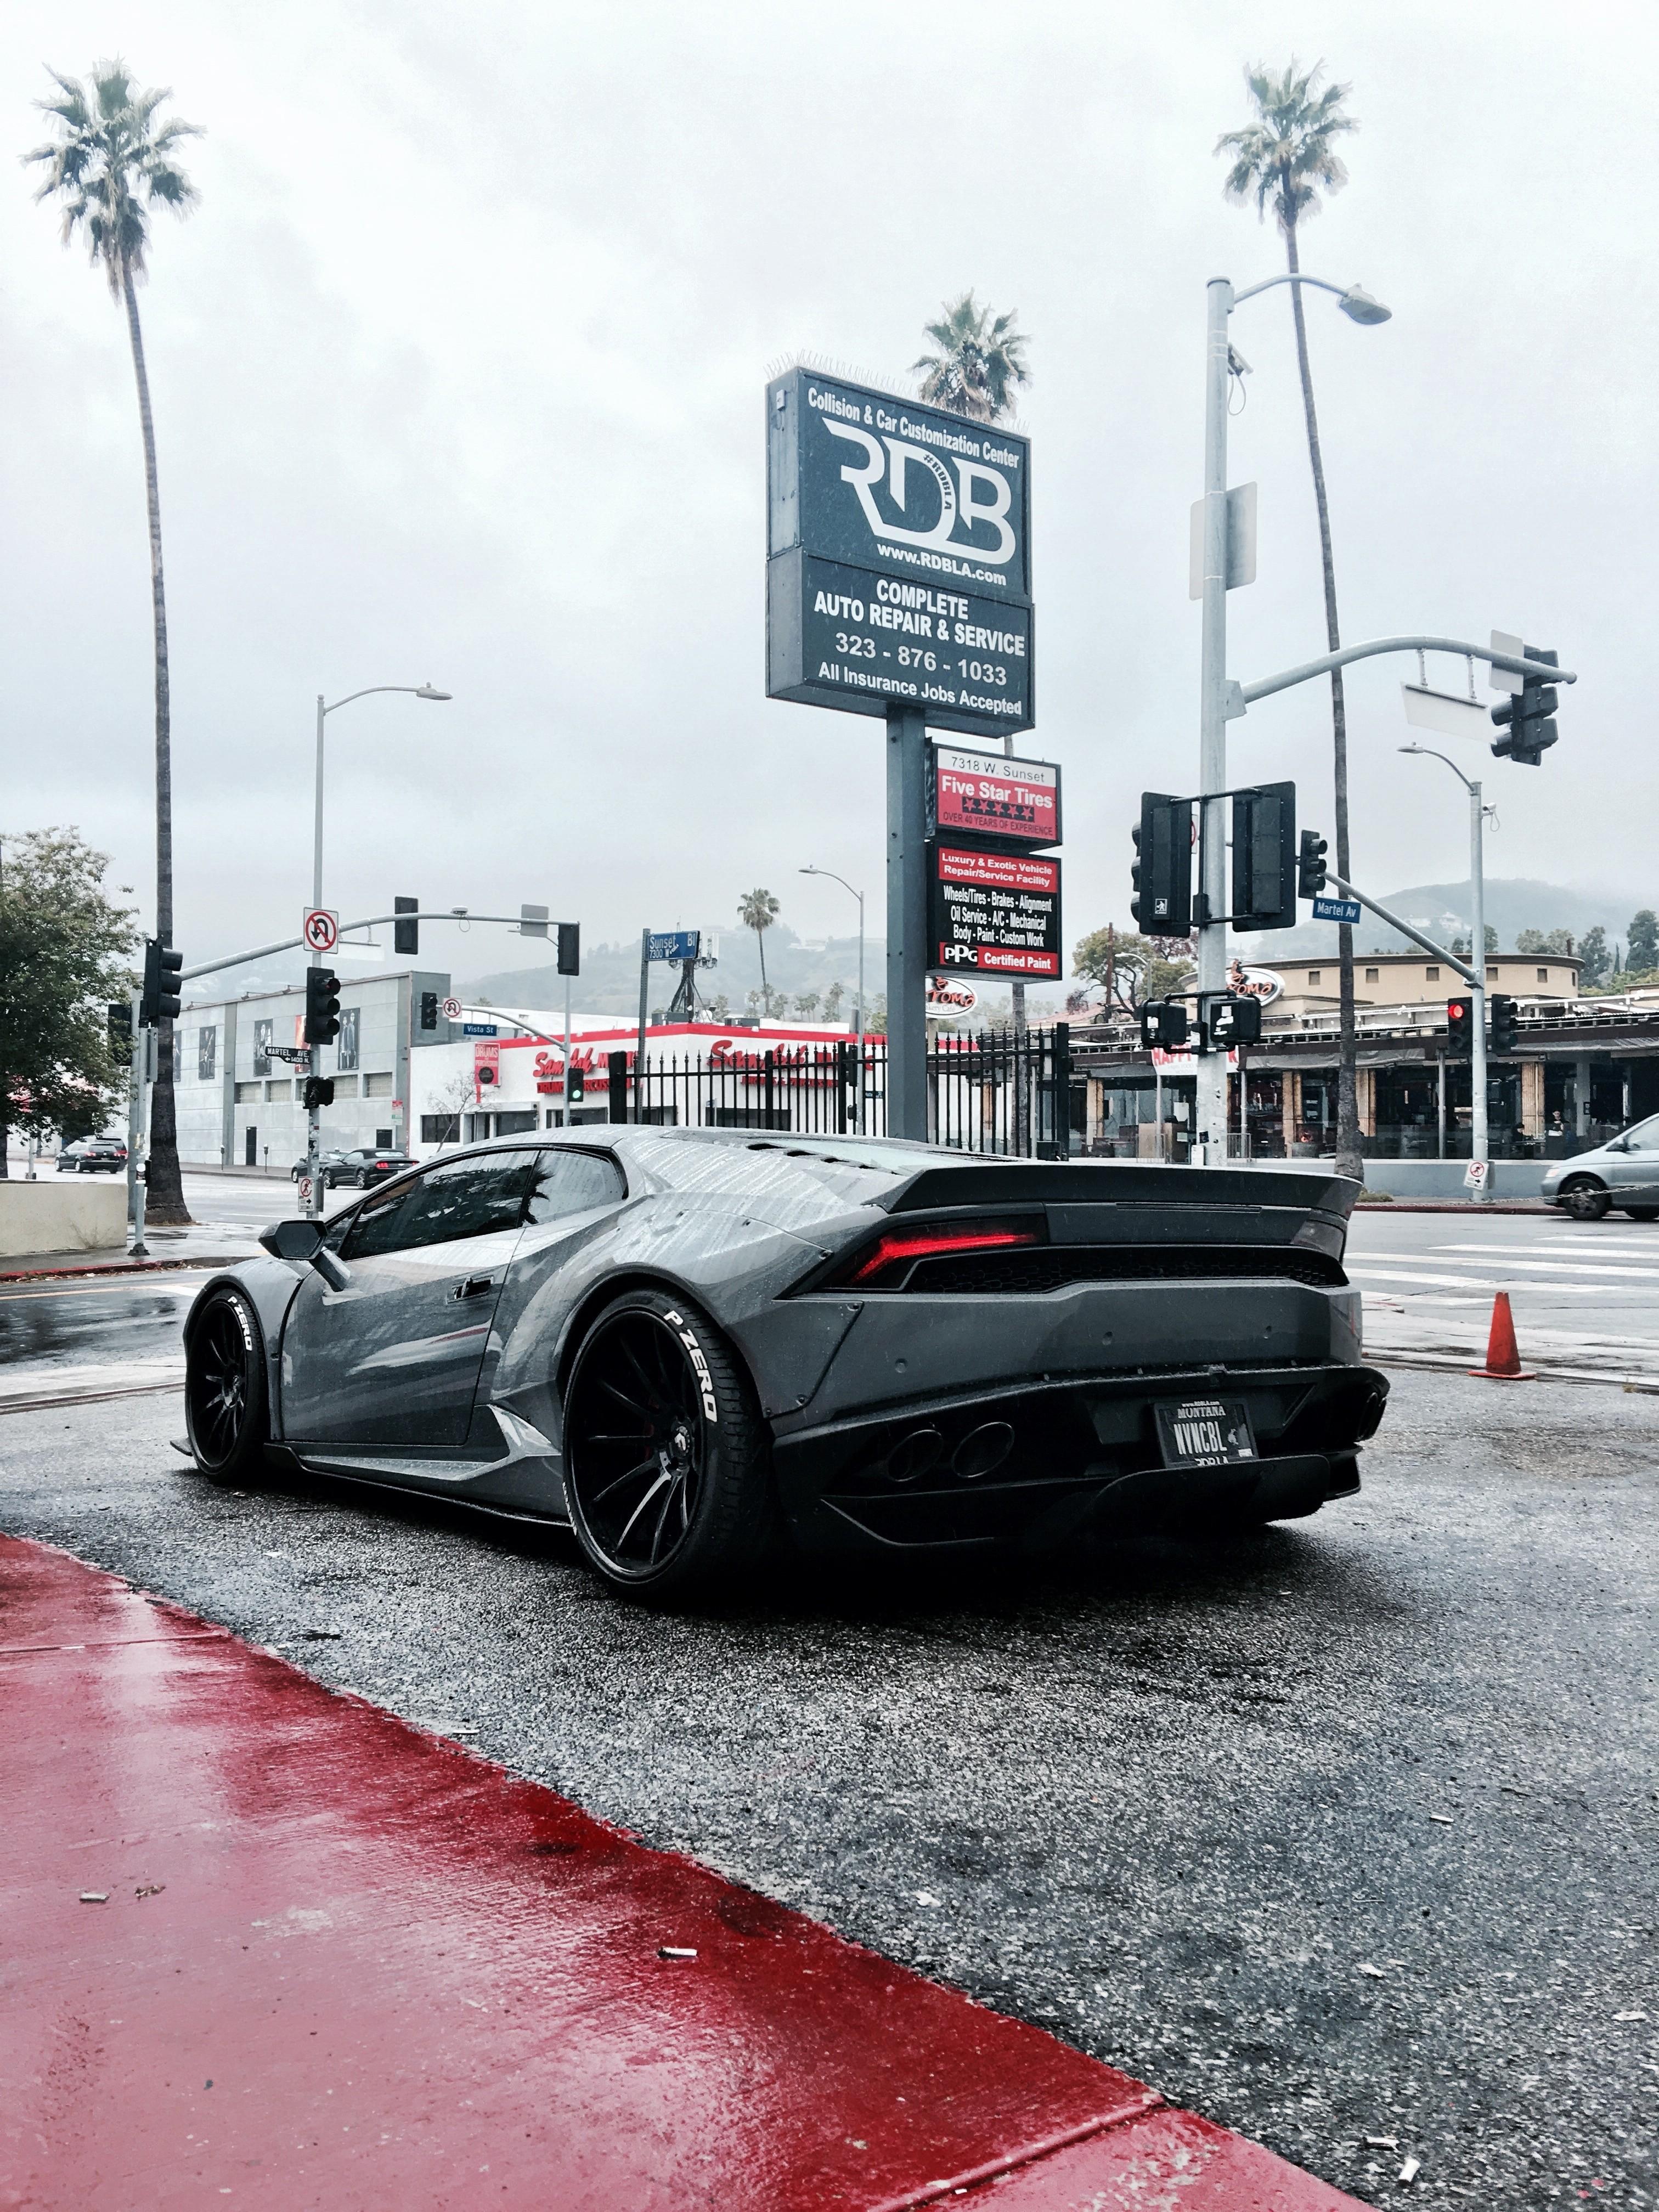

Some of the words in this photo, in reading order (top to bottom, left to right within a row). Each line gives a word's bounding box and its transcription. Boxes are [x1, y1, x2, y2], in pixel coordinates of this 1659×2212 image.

[808, 387, 860, 421] Collision
[864, 405, 873, 425] &
[876, 409, 897, 432] Car
[900, 416, 980, 457] Customization
[983, 442, 1019, 468] Center
[822, 417, 1016, 565] RDB
[877, 544, 1006, 586] www.RDBLA.com
[877, 579, 969, 620] COMPLETE
[814, 591, 864, 622] AUTO
[870, 603, 932, 637] REPAIR
[936, 619, 950, 641] &
[954, 623, 1025, 657] SERVICE
[836, 632, 876, 658] 323
[898, 646, 936, 672] 876
[958, 659, 1007, 686] 1033
[818, 662, 839, 681] All
[844, 666, 917, 696] Insurance
[921, 682, 956, 703] Jobs
[960, 690, 1022, 715] Accepted
[952, 757, 979, 771] 7318
[984, 762, 999, 775] W.
[1003, 766, 1045, 782] Sunset
[942, 775, 975, 796] Five
[979, 781, 1011, 802] Star
[1014, 787, 1053, 808] Tires
[944, 811, 963, 822] OVER
[965, 815, 972, 824] 40
[974, 816, 997, 828] YEARS
[1000, 820, 1008, 828] OF
[1011, 821, 1053, 836] EXPERIENCE
[942, 853, 975, 867] Luxury
[978, 858, 985, 866] &
[988, 859, 1017, 871] Exotic
[1018, 863, 1052, 874] Vehicle
[944, 865, 1014, 882] Repair/Service
[1016, 874, 1050, 887] Facility
[944, 885, 986, 905] Wheels/Tires
[991, 891, 1014, 908] Brakes
[1019, 895, 1052, 913] Alignment
[1317, 901, 1344, 916] Martel
[1345, 906, 1357, 917] Av
[951, 905, 961, 921] Oil
[962, 907, 987, 924] Service
[992, 910, 1005, 927] A/C
[1010, 912, 1046, 930] Mechanical
[650, 935, 676, 950] Sunset
[687, 933, 695, 946] Bl
[953, 924, 972, 943] Body
[977, 927, 995, 943] Paint
[1000, 929, 1025, 945] Custom
[1026, 932, 1044, 947] Work
[649, 949, 663, 958] 7300
[945, 944, 978, 963] PPG
[984, 952, 1025, 967] Certified
[1028, 957, 1051, 969] Paint
[267, 1047, 291, 1056] MARTEL
[475, 1047, 498, 1058] DRUMS
[533, 1052, 565, 1077] Sam
[537, 1082, 565, 1093] DRUM
[234, 1304, 252, 1351] ZERO
[663, 1310, 684, 1325] P
[679, 1329, 717, 1422] ZERO
[1177, 1406, 1226, 1418] MONTANA
